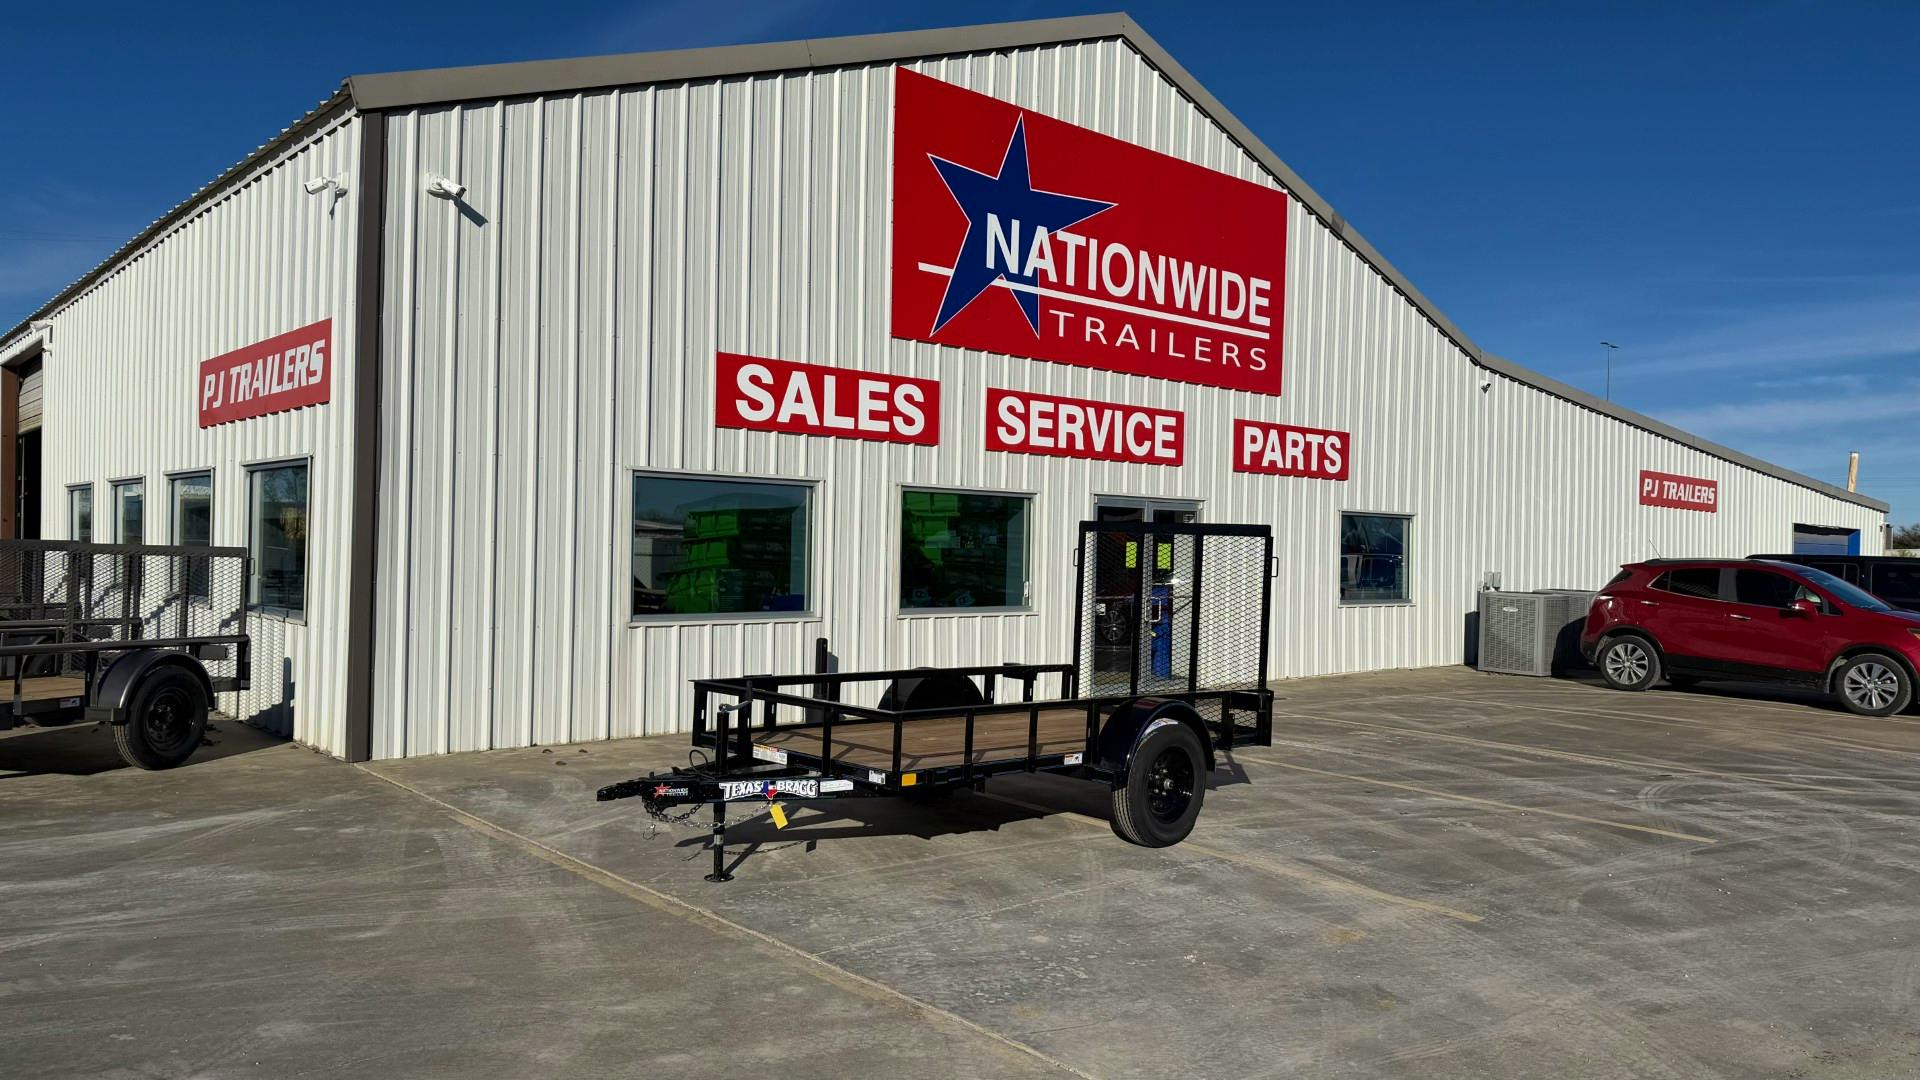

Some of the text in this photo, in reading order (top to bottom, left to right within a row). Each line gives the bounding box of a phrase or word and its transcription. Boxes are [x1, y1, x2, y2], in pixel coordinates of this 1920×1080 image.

[986, 212, 1271, 327] NATIONWIDE
[1049, 309, 1267, 371] TRAILERS
[203, 339, 325, 411] PJ TRAILERS
[736, 364, 925, 436] SALES
[997, 396, 1176, 458] SERVICE
[1243, 425, 1343, 474] PARTS
[1643, 478, 1715, 504] PJ TRAILERS
[719, 781, 763, 800] TEXAS
[775, 780, 818, 797] BRAGG
